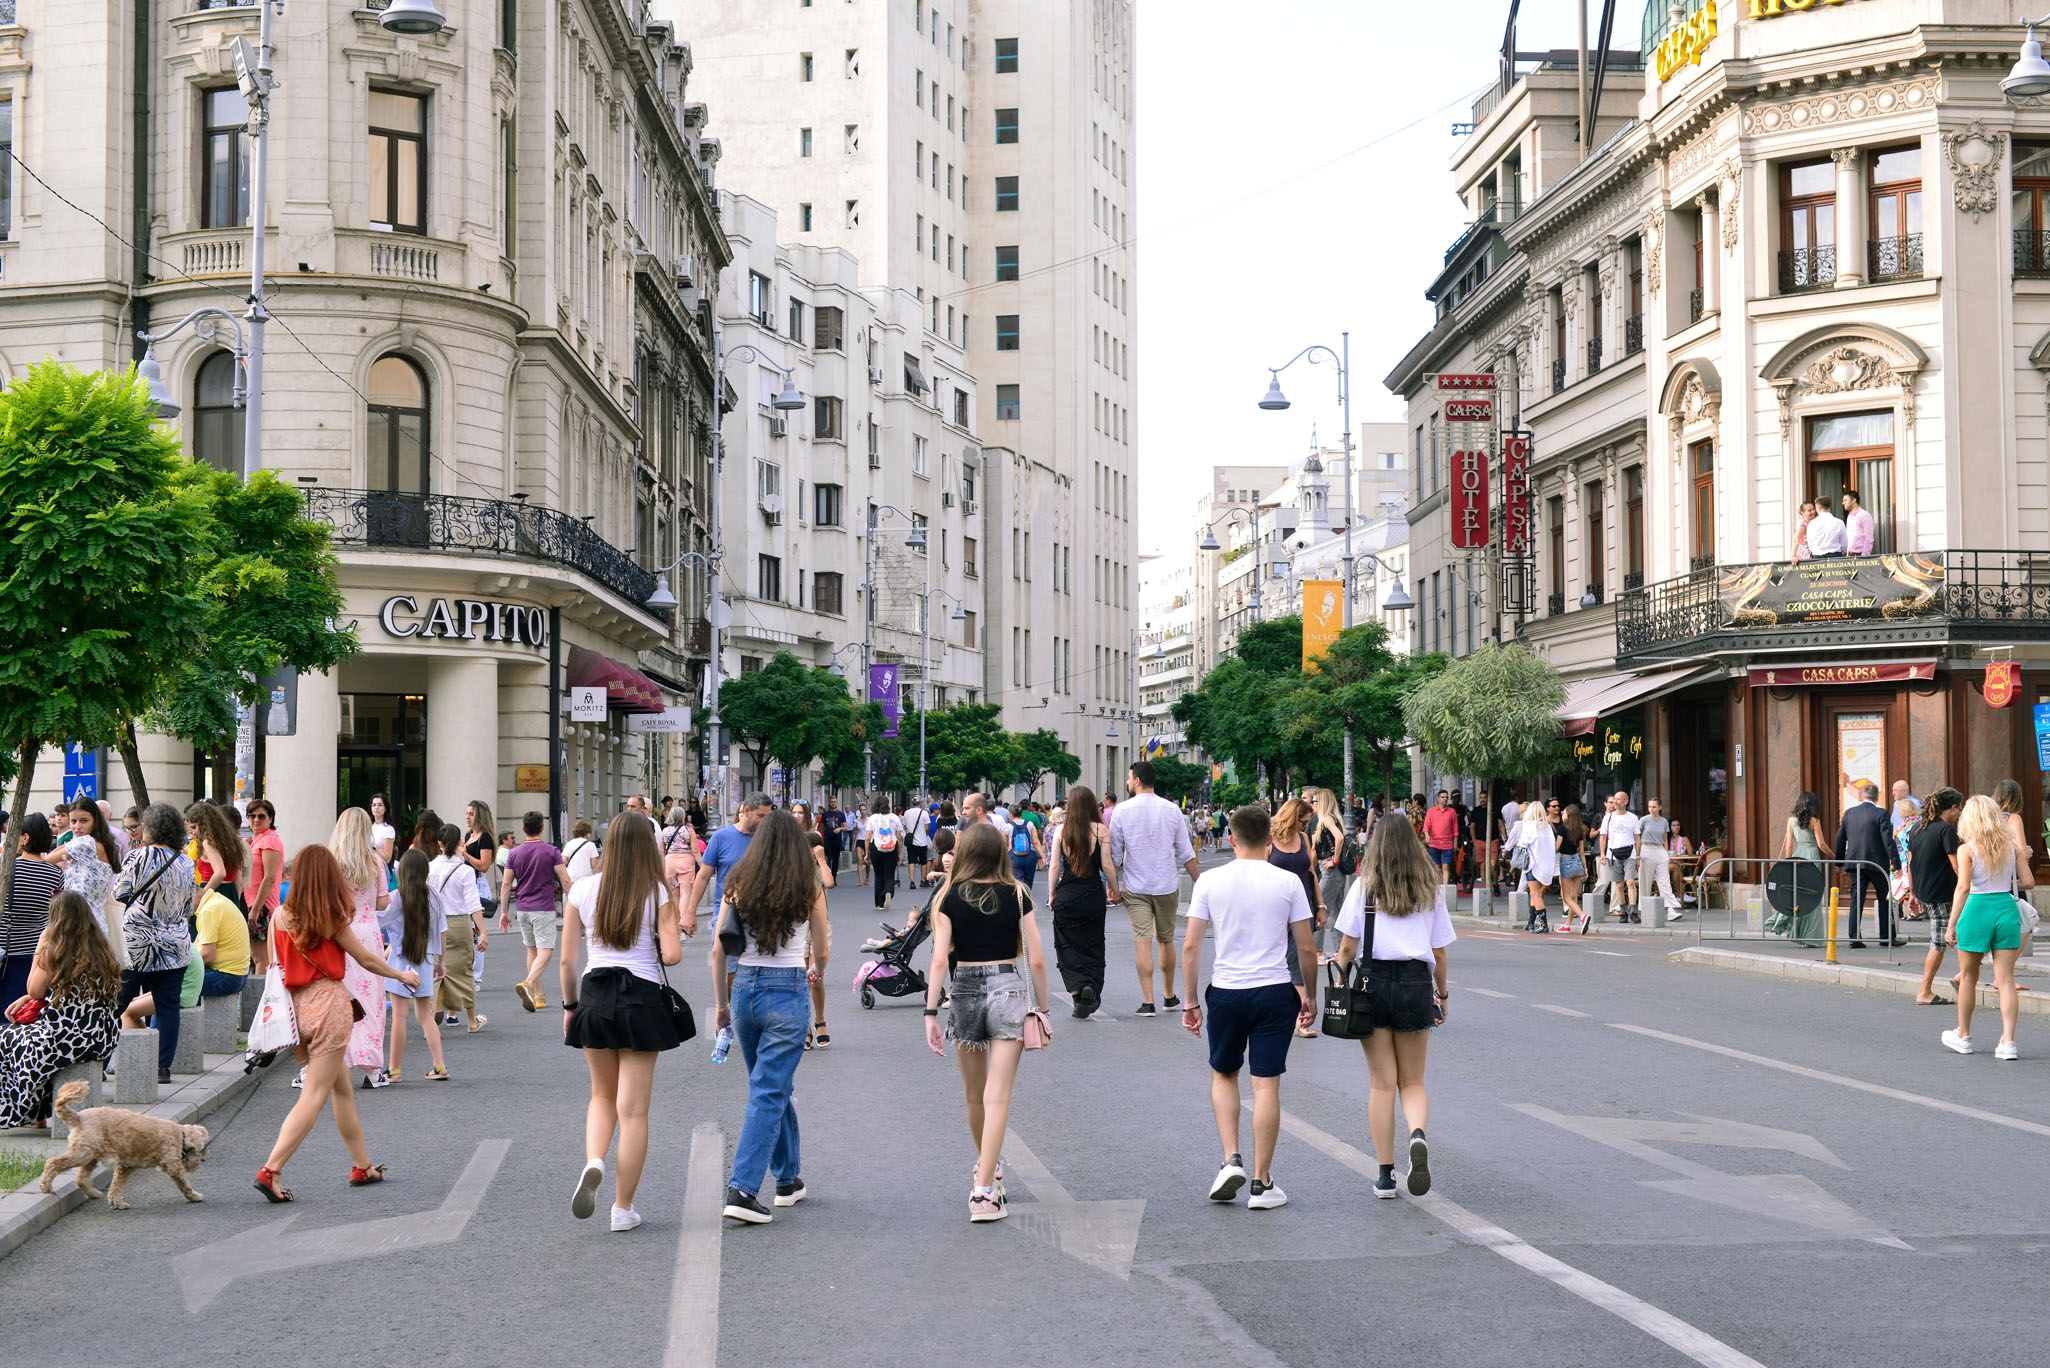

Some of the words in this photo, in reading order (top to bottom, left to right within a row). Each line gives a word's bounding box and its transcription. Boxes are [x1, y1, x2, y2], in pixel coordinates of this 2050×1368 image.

[1461, 450, 1480, 548] HOTEL
[1801, 591, 1824, 599] CASA
[379, 595, 551, 649] CAPITOL
[1802, 668, 1836, 682] CASA
[1837, 667, 1880, 681] CAPSA
[1336, 1008, 1347, 1016] BAG
